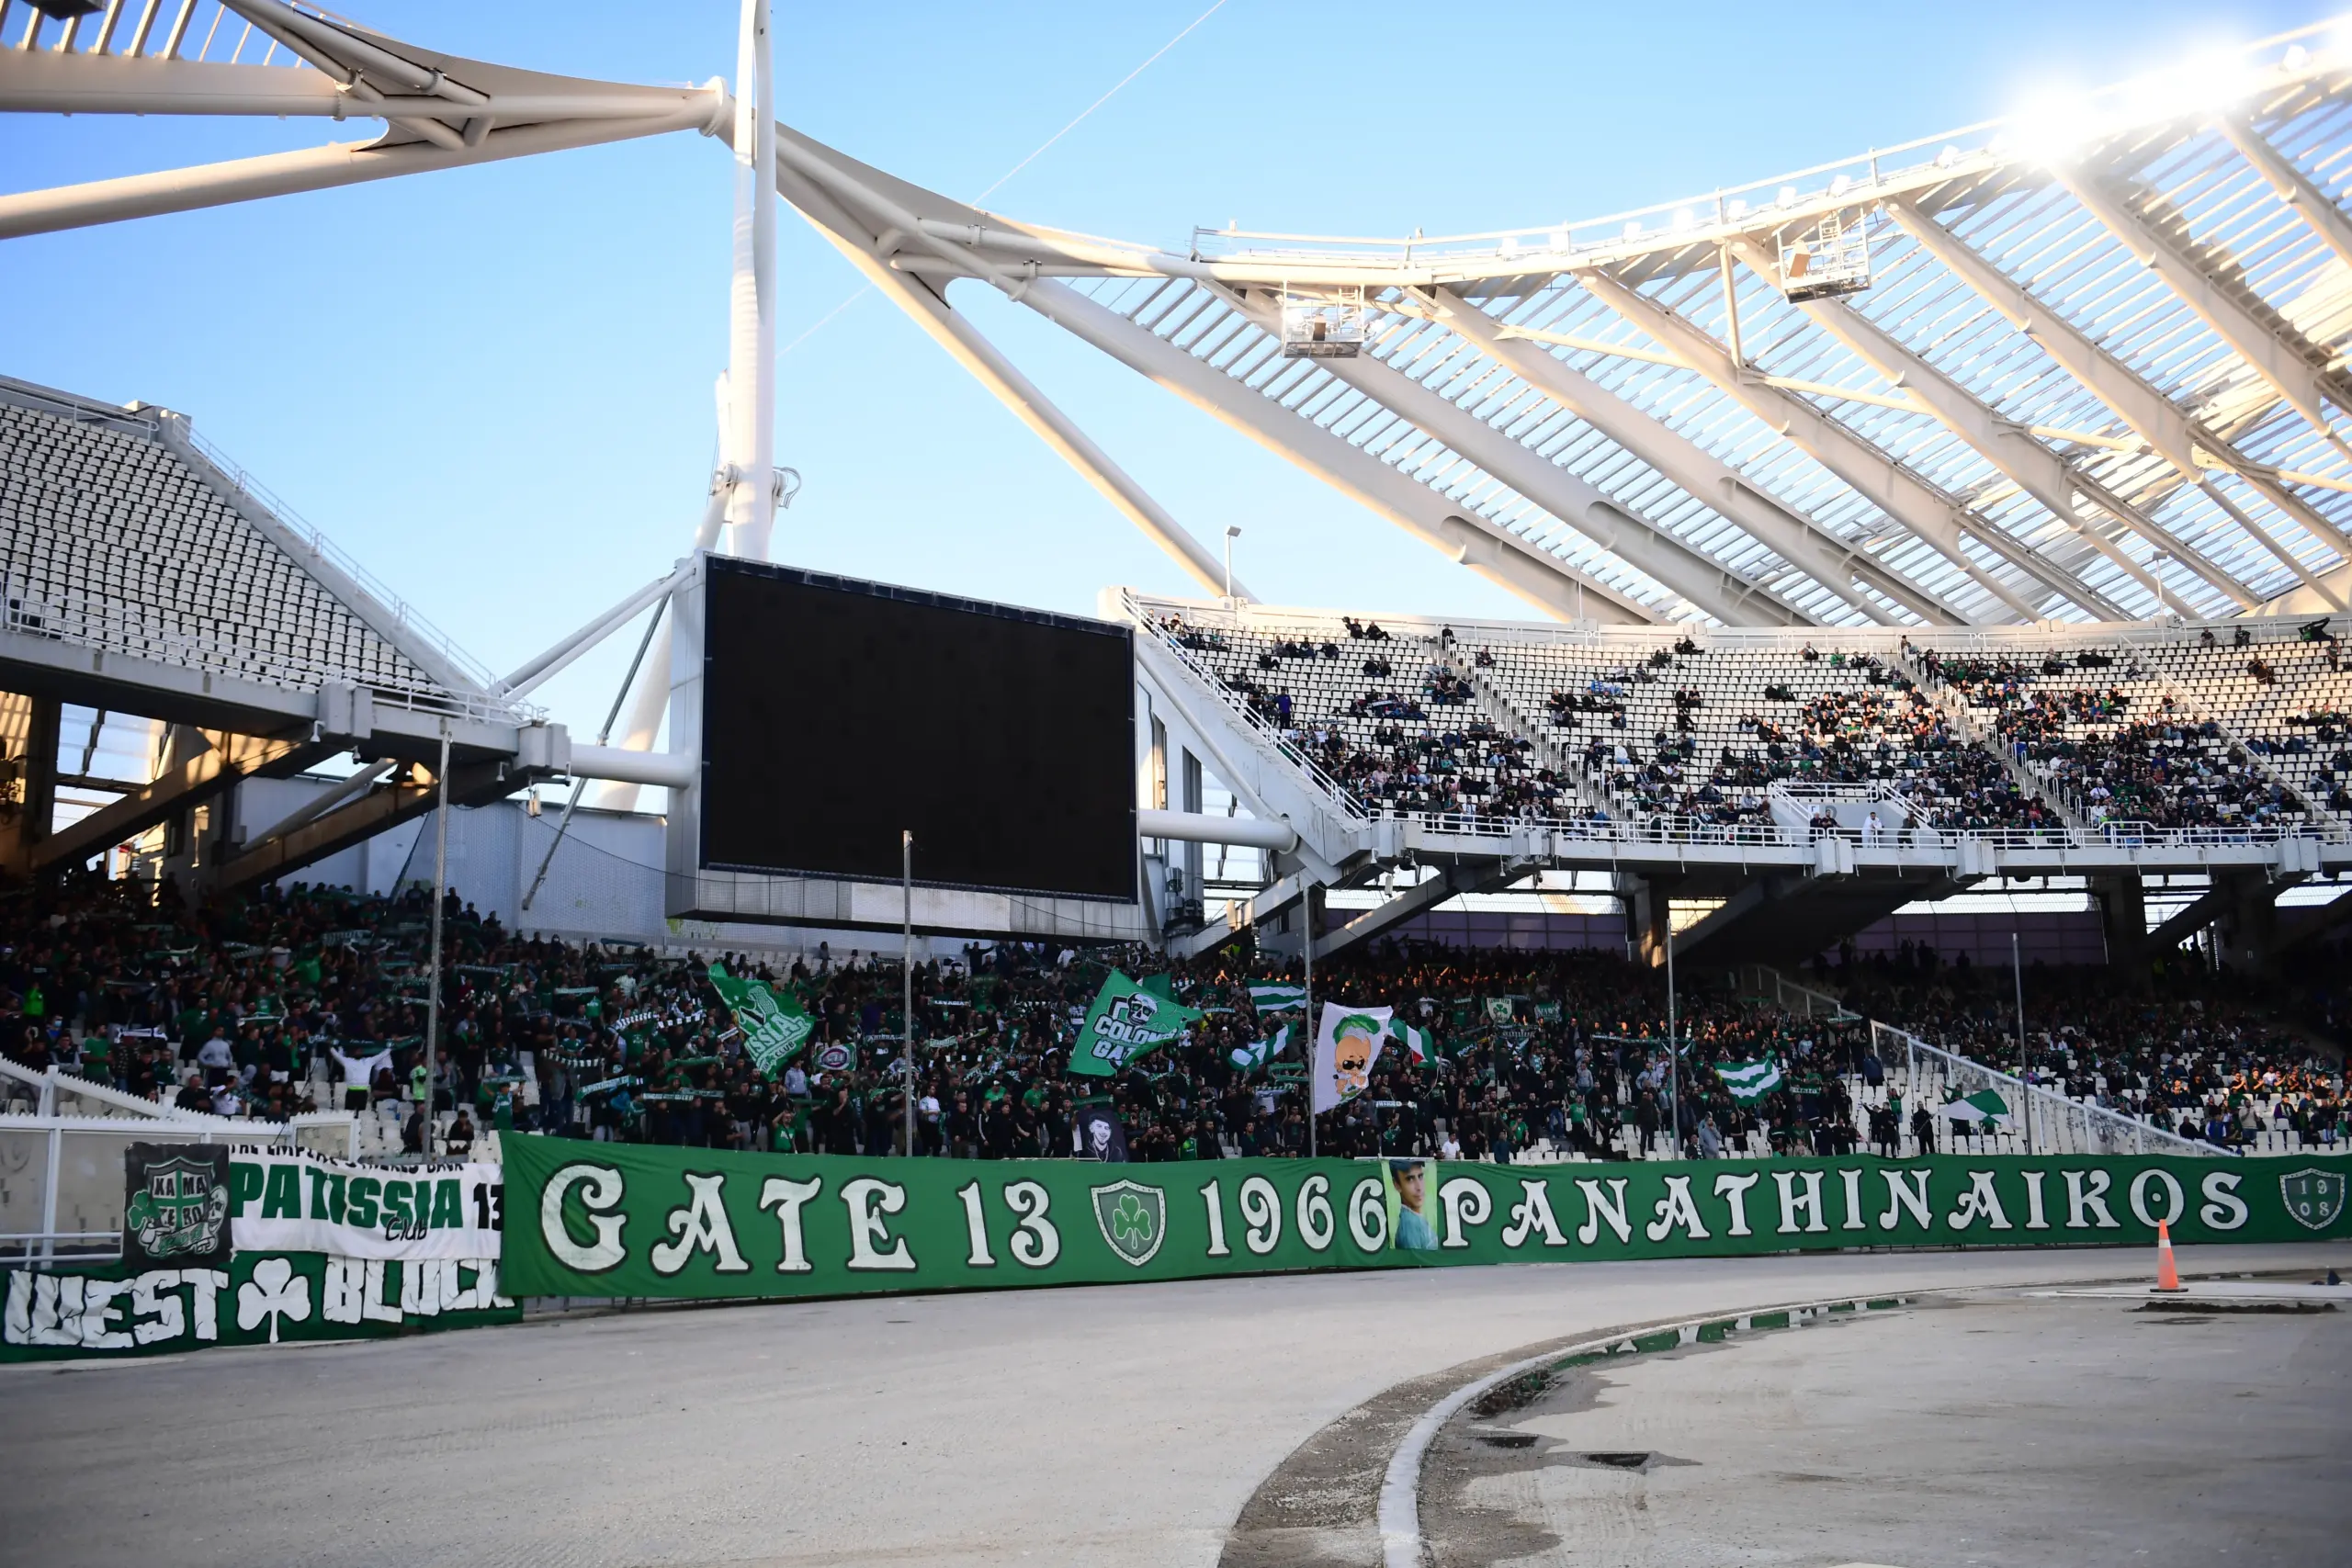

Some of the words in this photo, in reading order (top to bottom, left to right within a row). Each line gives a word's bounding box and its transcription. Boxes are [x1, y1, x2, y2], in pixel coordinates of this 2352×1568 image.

[775, 1041, 796, 1057] CLUB
[230, 1162, 464, 1230] PATISSIA
[473, 1182, 504, 1232] 13
[385, 1216, 429, 1241] Club
[540, 1161, 918, 1274] GATE
[956, 1178, 1061, 1269] 13
[1198, 1174, 1388, 1255] 1966
[1439, 1168, 2250, 1247] PANATHINAIKOS
[4, 1269, 230, 1348] WEST
[322, 1256, 515, 1325] BLOCK
